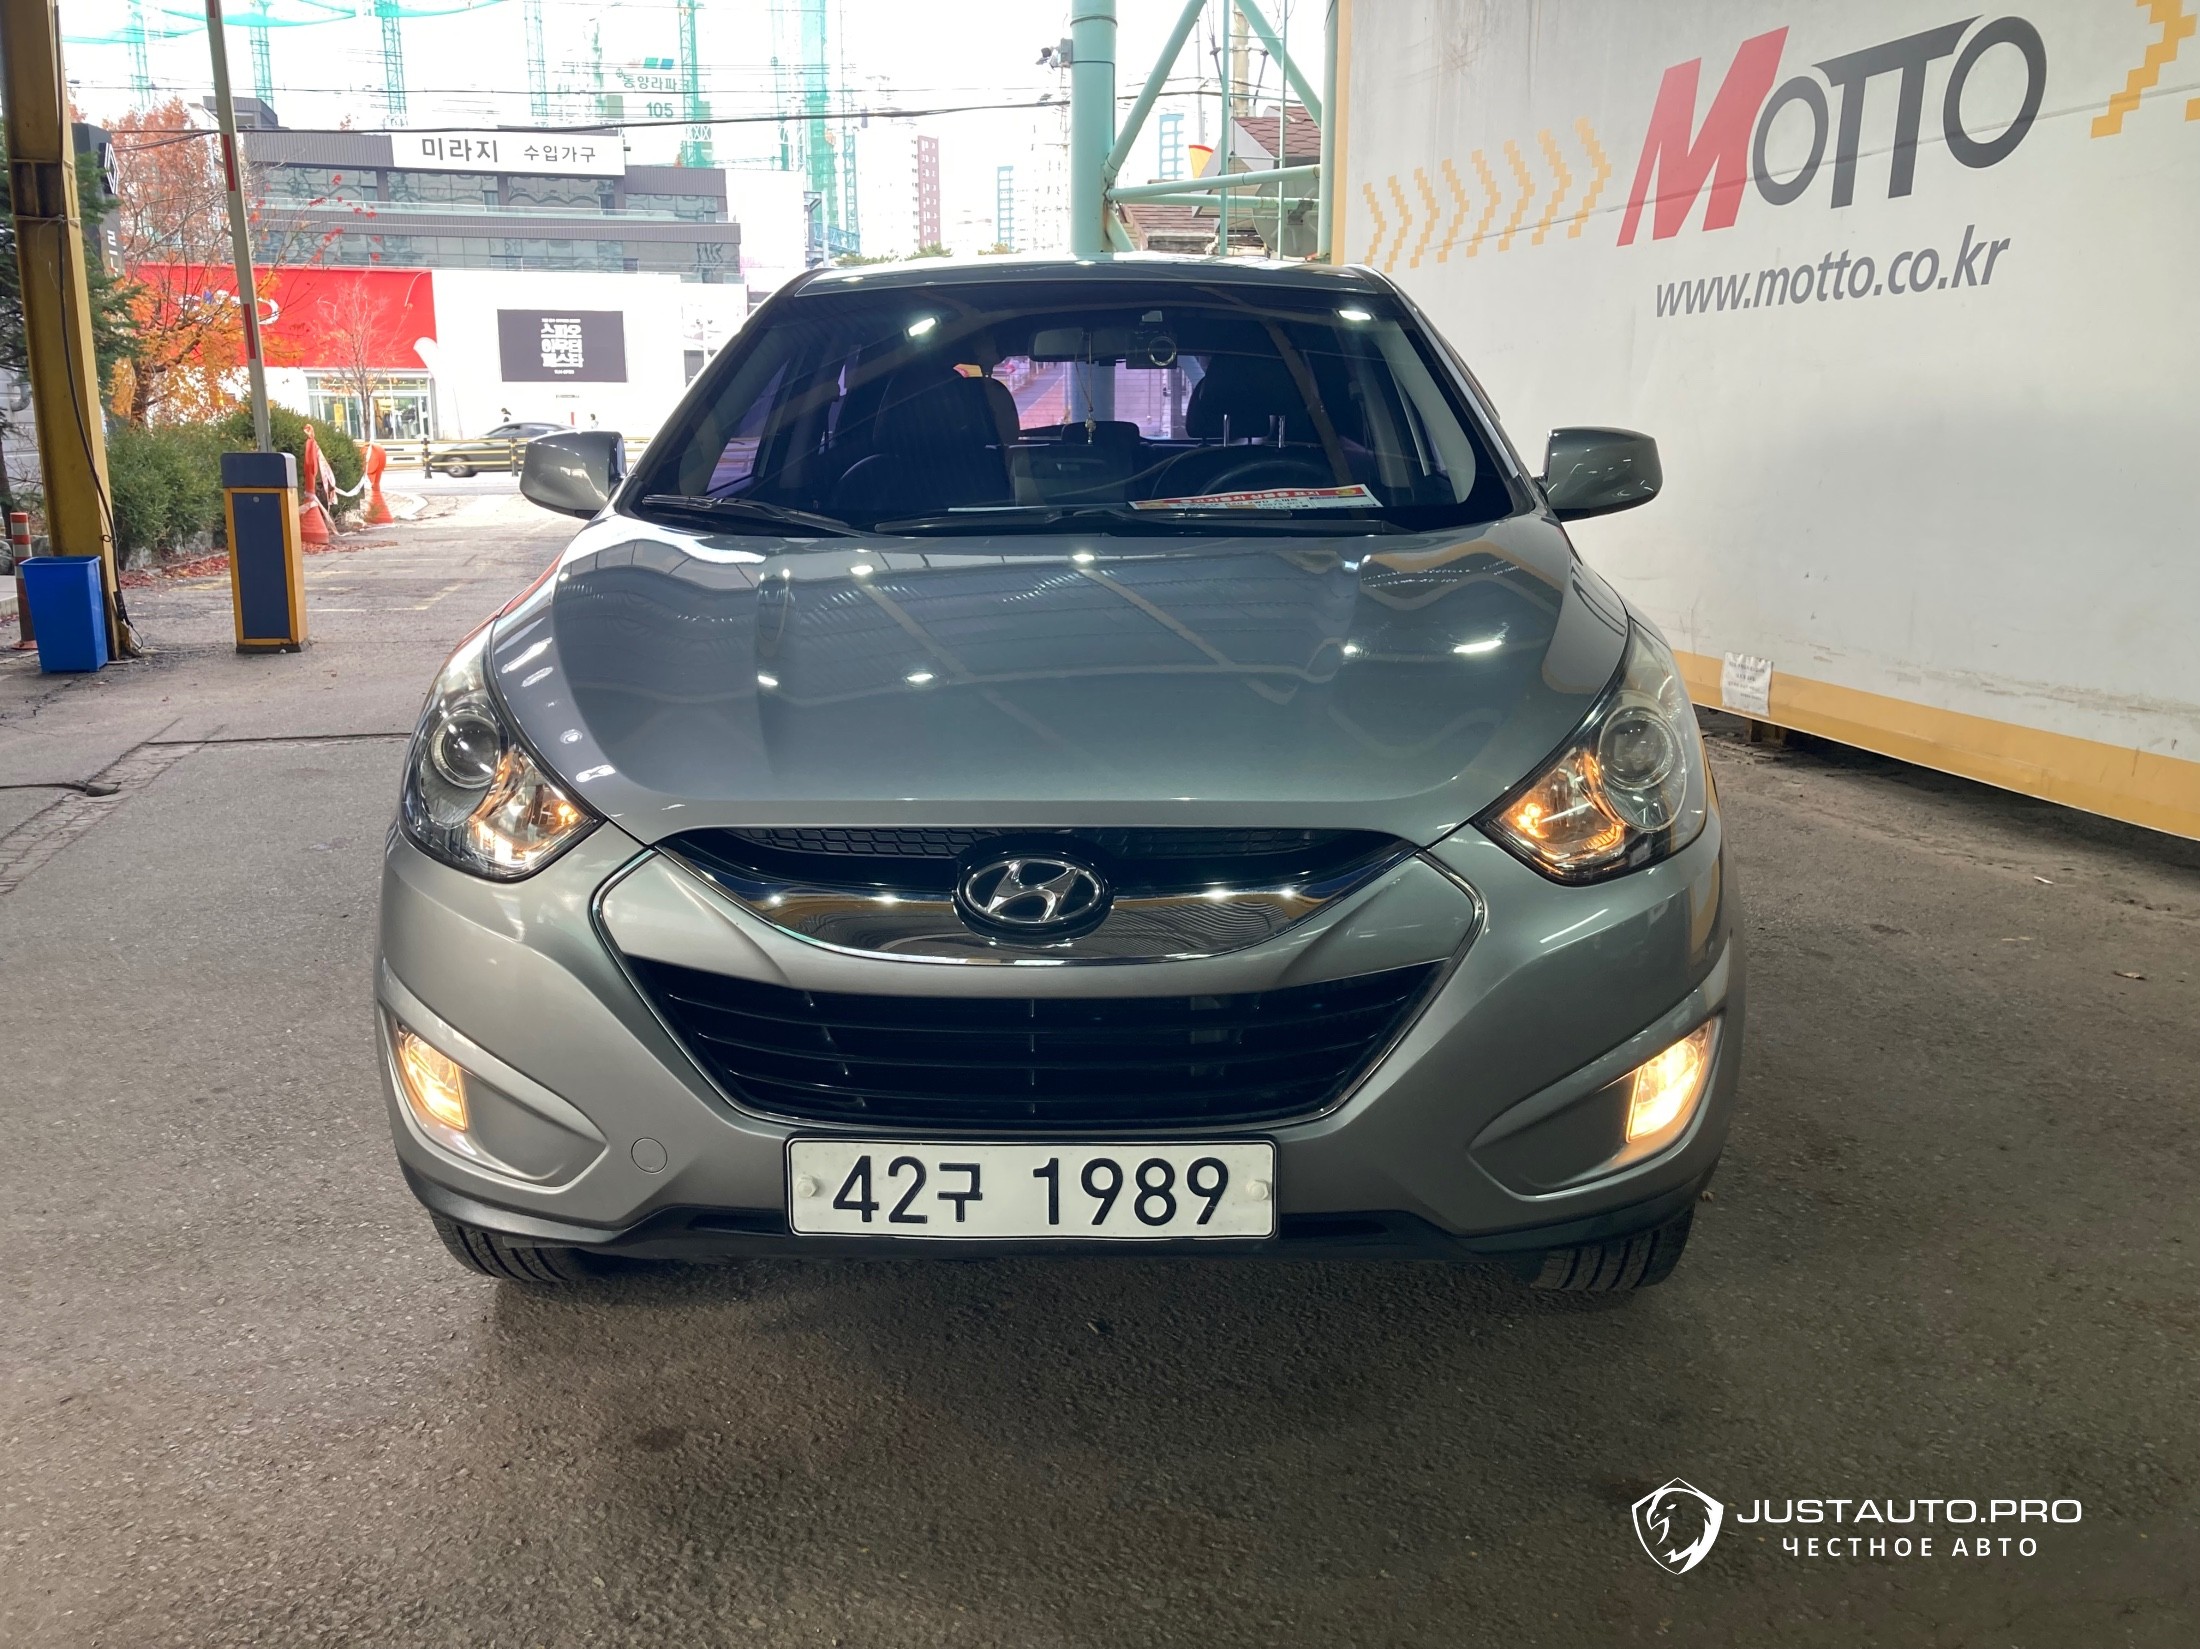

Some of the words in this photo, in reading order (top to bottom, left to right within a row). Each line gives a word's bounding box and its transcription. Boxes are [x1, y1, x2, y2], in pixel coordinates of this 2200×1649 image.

[646, 101, 674, 118] 105
[1616, 13, 2048, 248] MOTTO
[421, 137, 499, 163] 미라지
[523, 144, 597, 163] 수입가구
[1655, 224, 2011, 318] www.motto.co.kr
[832, 1155, 984, 1225] 42구
[1032, 1157, 1230, 1226] 1989
